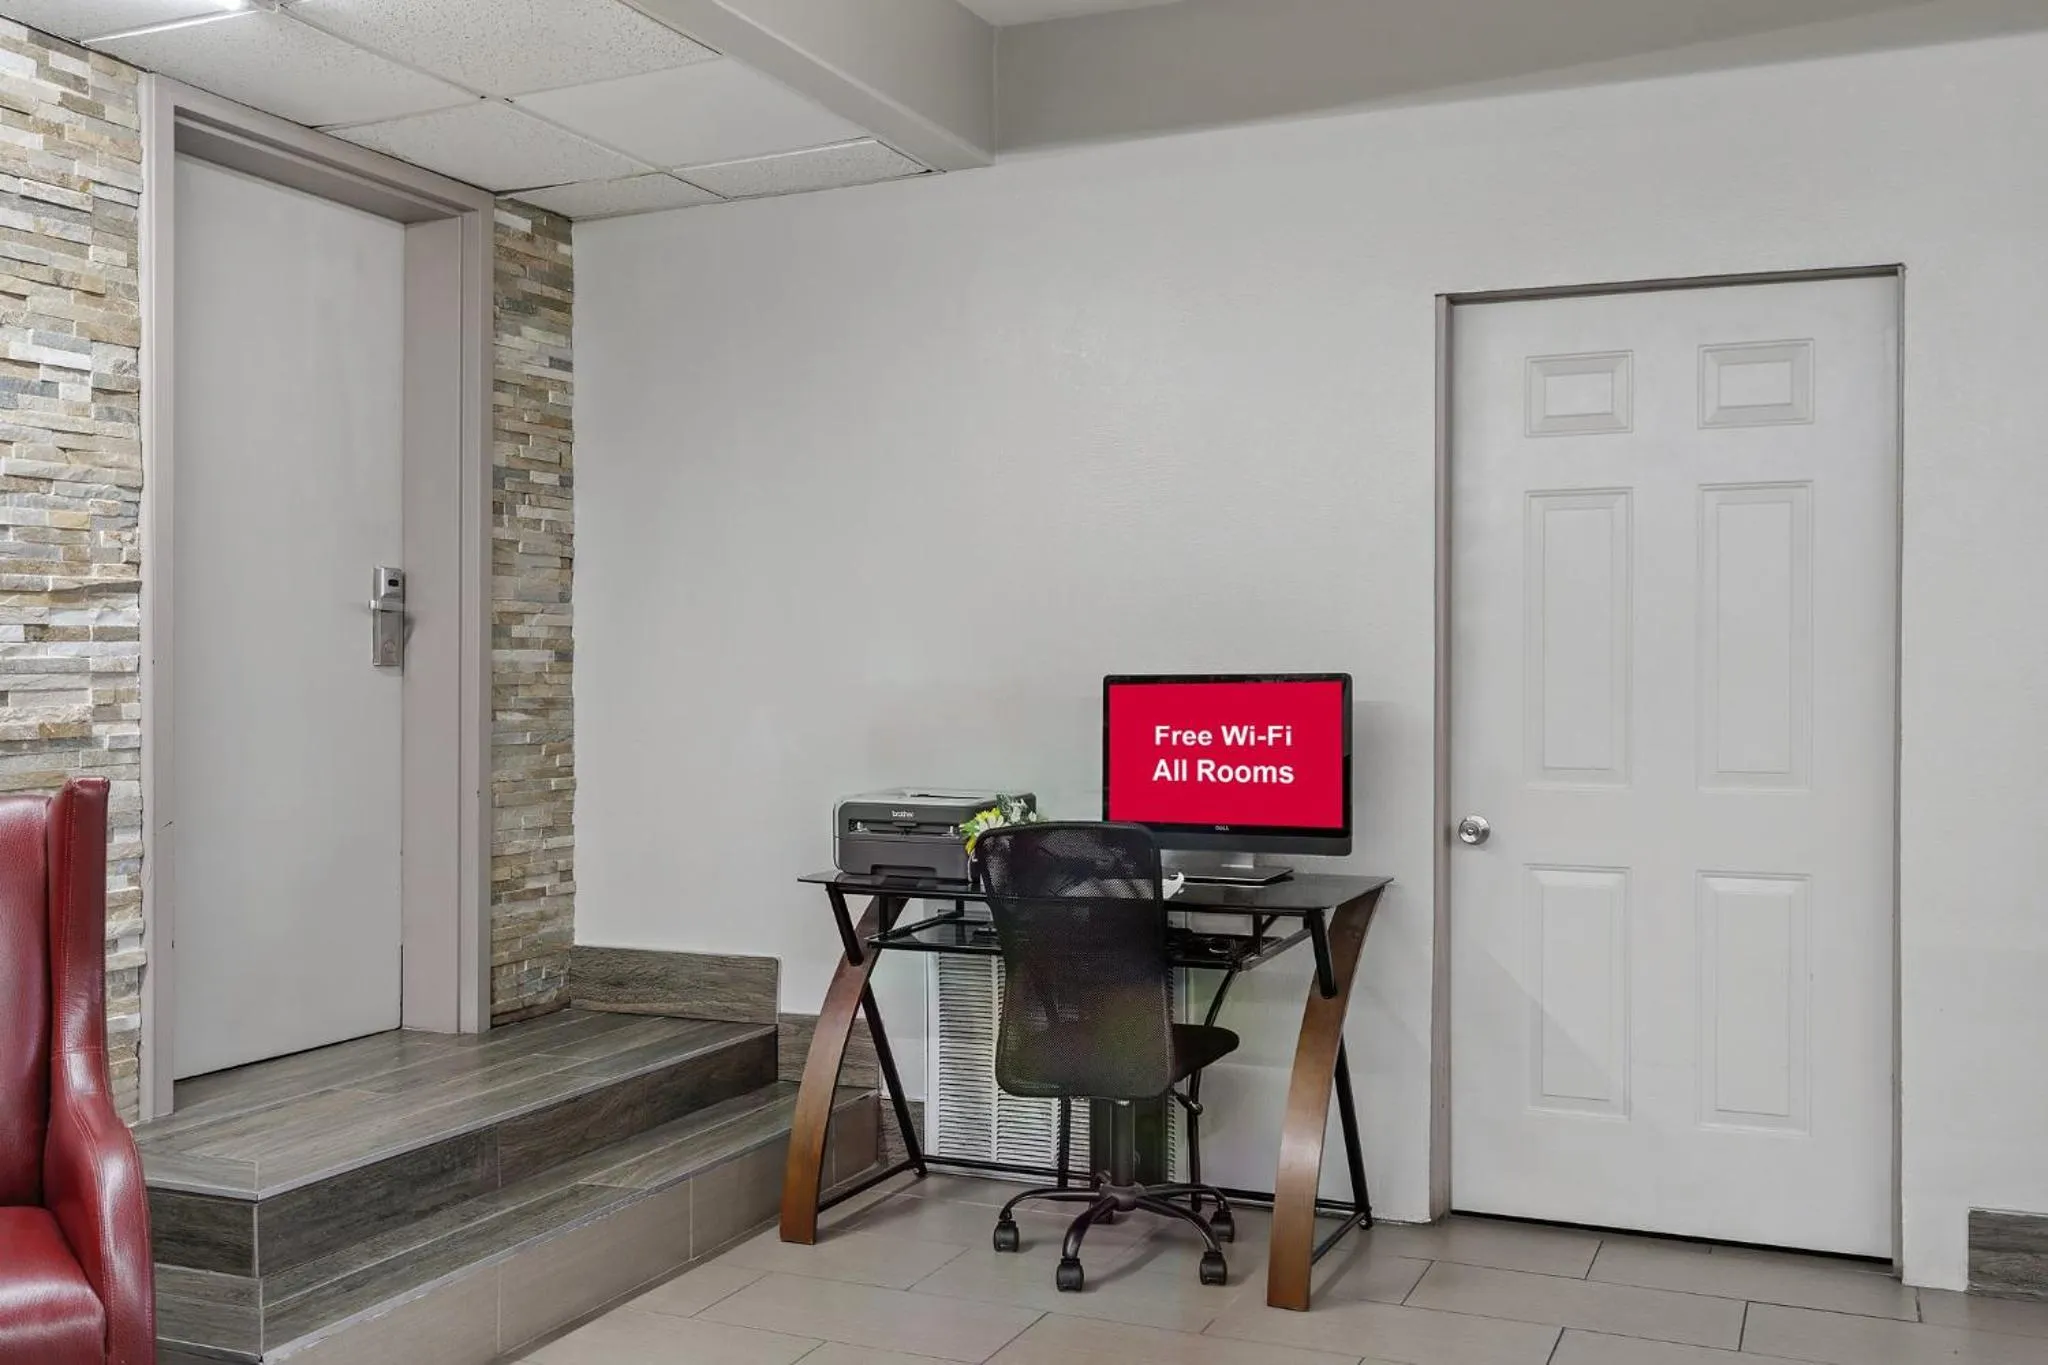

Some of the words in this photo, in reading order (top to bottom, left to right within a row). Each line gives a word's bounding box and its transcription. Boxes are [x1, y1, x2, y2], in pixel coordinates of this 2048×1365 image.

[1154, 725, 1213, 746] Free
[1220, 725, 1292, 746] Wi-Fi
[1152, 758, 1188, 782] All
[1197, 759, 1295, 784] Rooms
